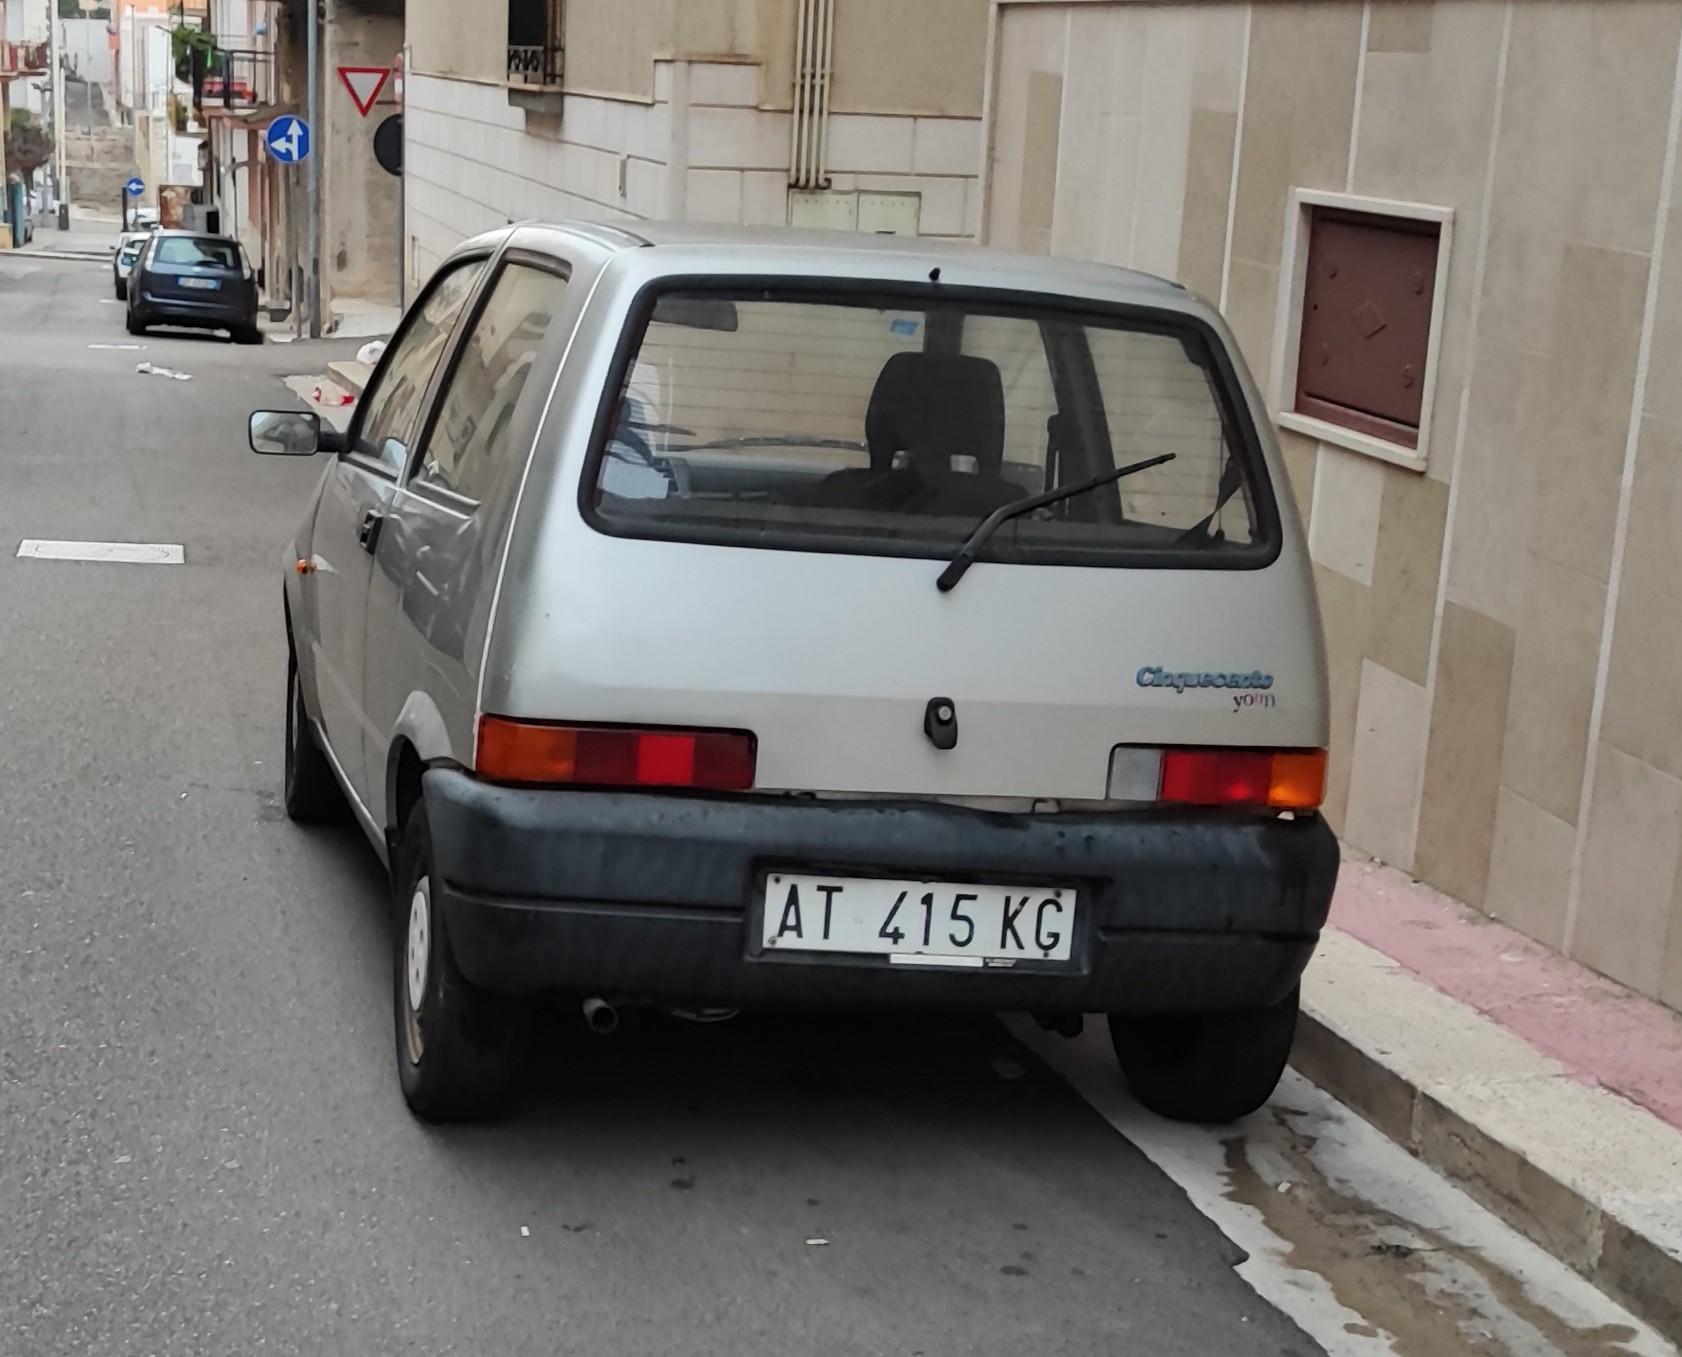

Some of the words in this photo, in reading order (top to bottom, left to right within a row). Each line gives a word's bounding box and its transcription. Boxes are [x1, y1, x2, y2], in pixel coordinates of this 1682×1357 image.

[1136, 666, 1274, 694] Cinquecento
[777, 883, 844, 940] AT
[878, 890, 978, 947] 415
[1000, 894, 1063, 951] KG
